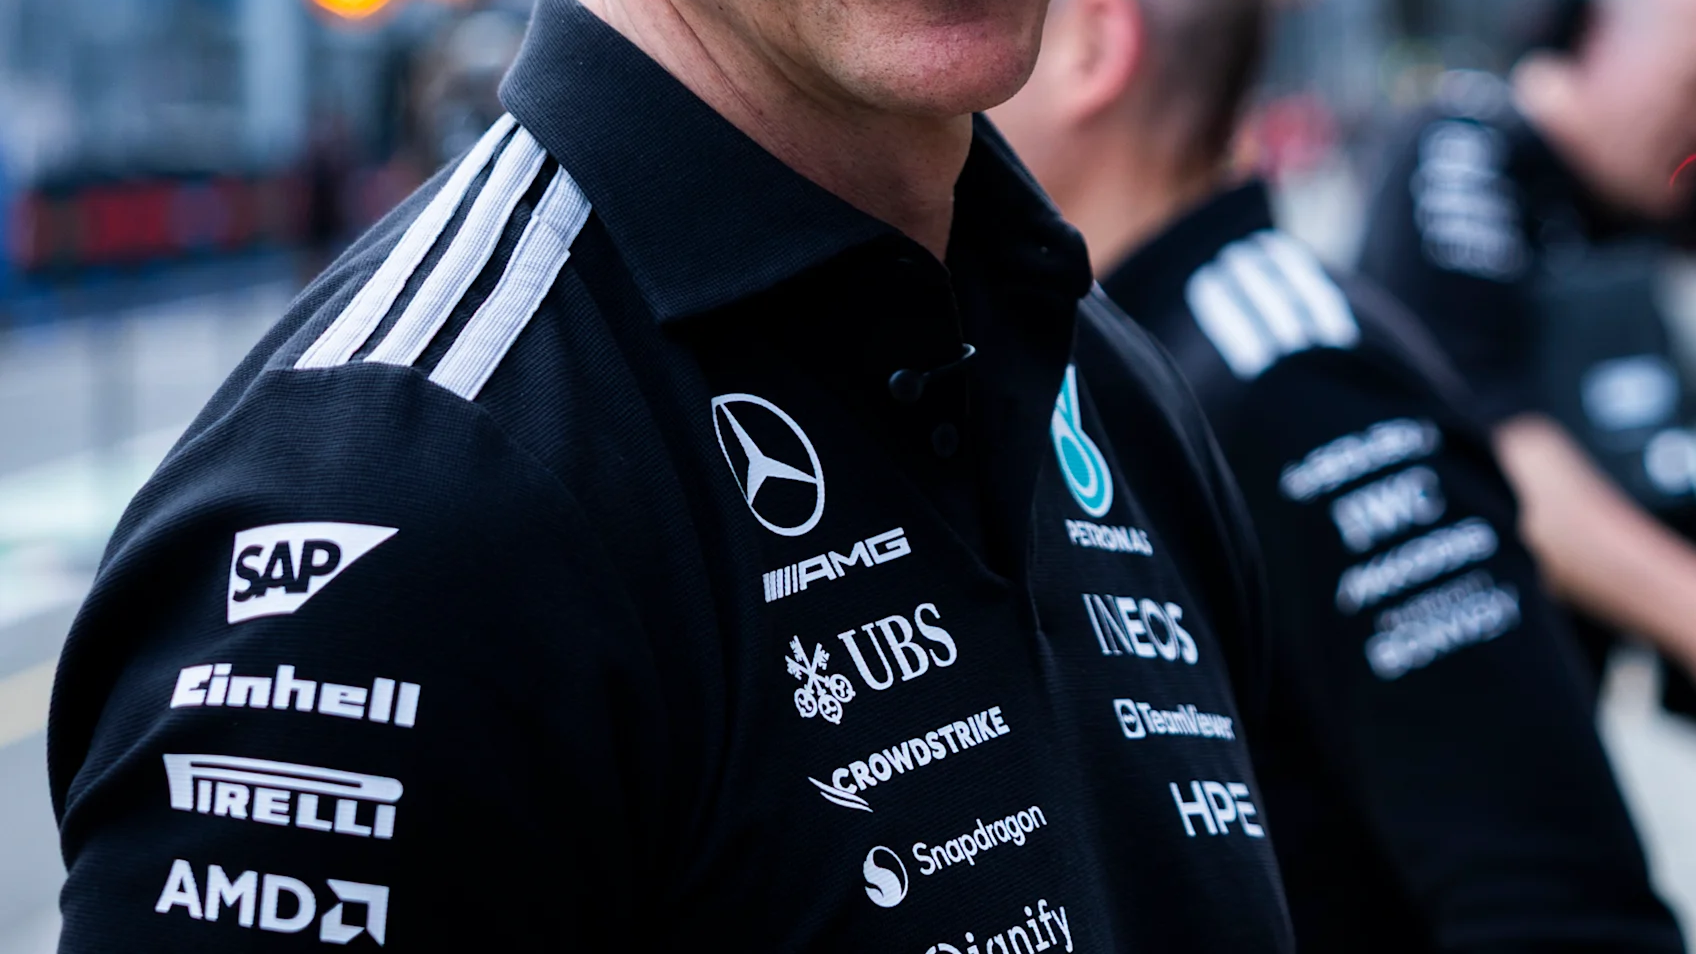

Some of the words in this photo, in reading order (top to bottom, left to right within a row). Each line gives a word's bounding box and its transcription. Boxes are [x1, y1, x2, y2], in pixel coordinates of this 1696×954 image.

[233, 539, 341, 602] SAP
[799, 527, 911, 590] AMG
[1065, 519, 1153, 556] PETRONAS
[837, 603, 957, 691] UBS
[1083, 593, 1198, 664] INEOS
[170, 663, 420, 728] Einhell
[831, 706, 1011, 796] CROWDSTRIKE
[163, 754, 404, 839] PIRELLI
[1169, 780, 1265, 838] HPE
[912, 805, 1048, 876] Snapdragon
[155, 859, 317, 933] AMD
